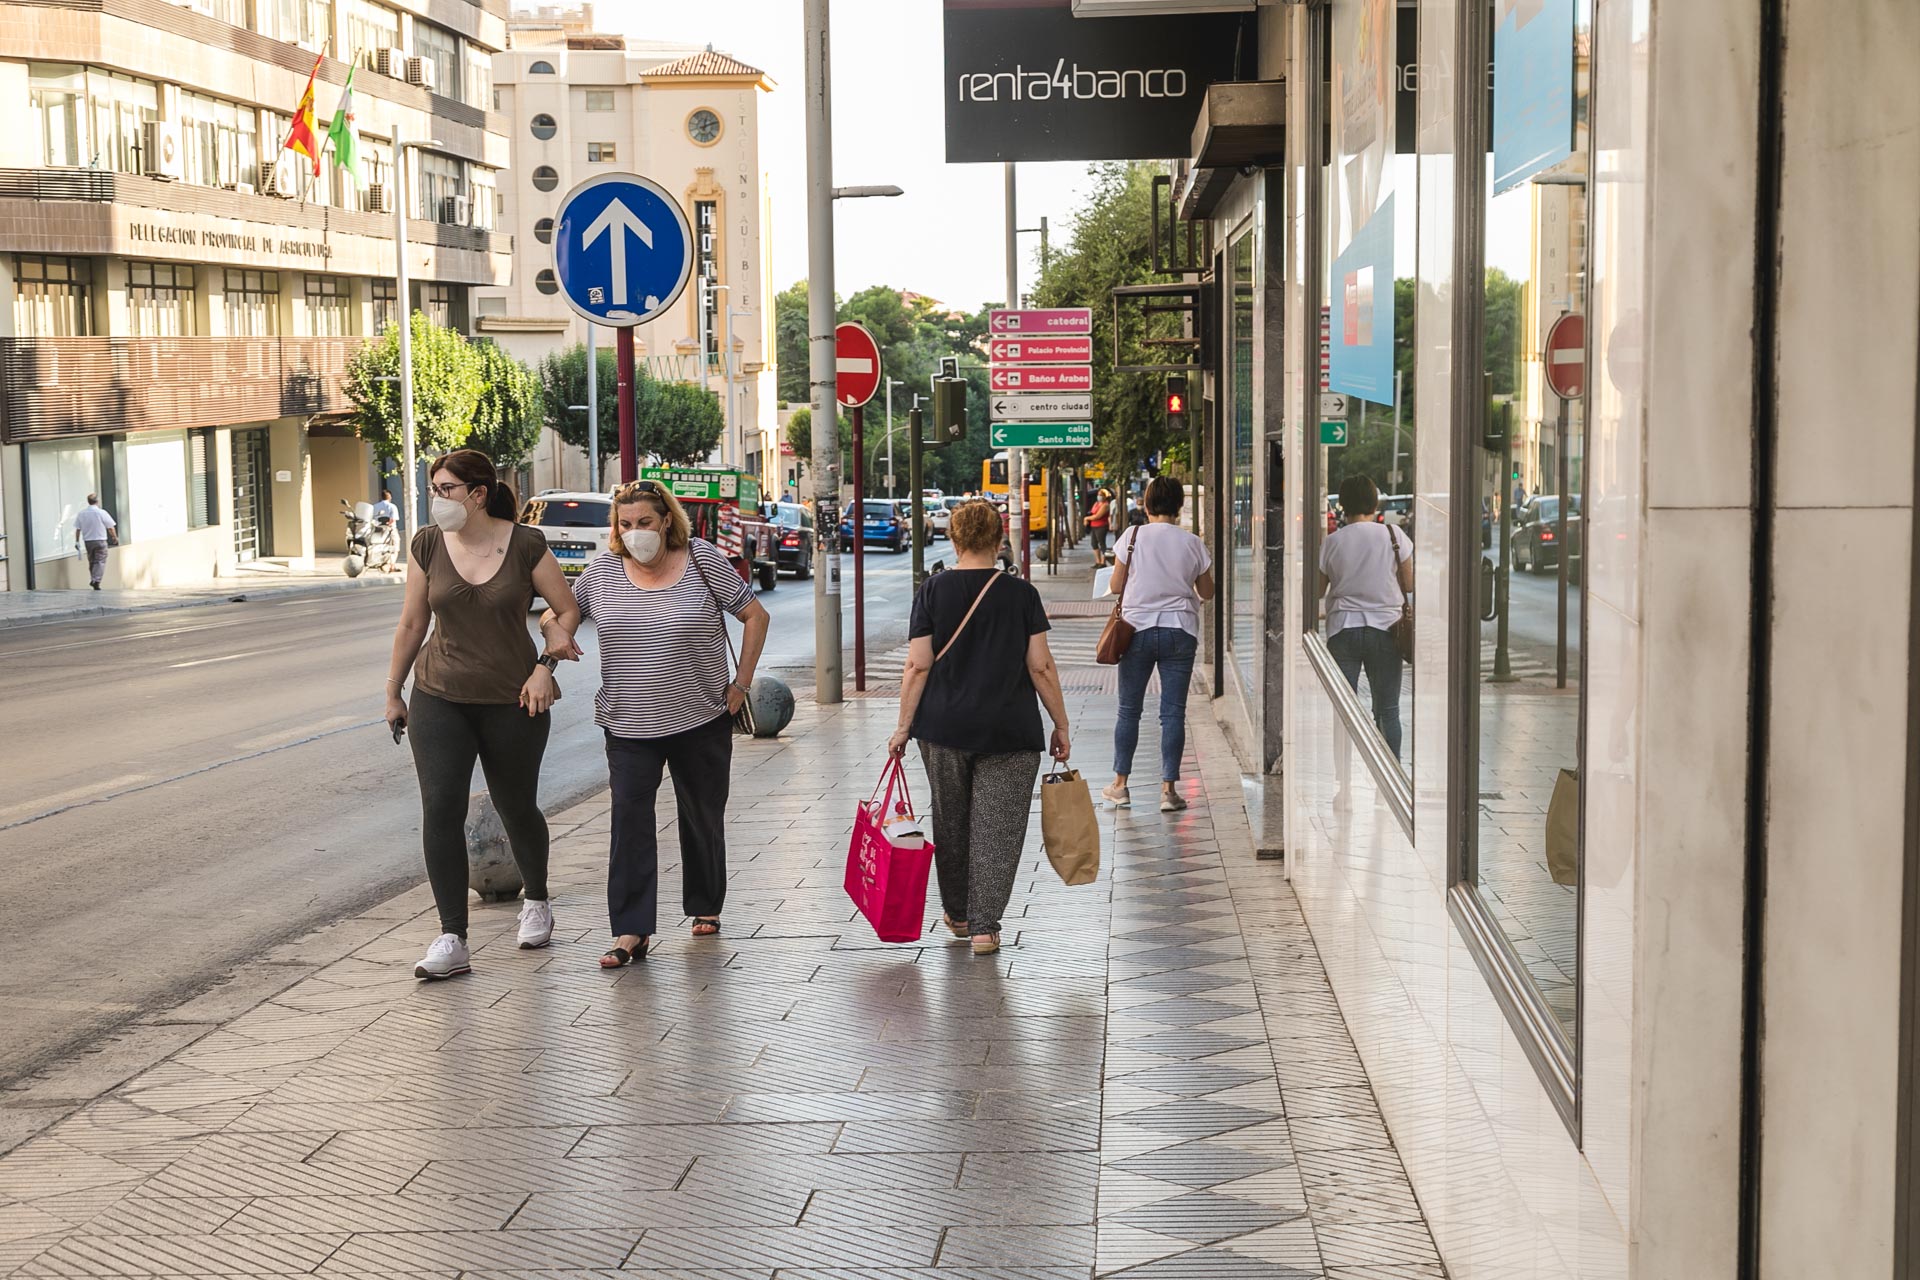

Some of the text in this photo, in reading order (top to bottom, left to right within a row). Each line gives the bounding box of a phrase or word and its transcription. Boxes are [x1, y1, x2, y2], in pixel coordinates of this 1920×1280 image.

[959, 58, 1187, 101] renta4banco
[202, 231, 256, 252] PROVINCIAL
[263, 237, 273, 253] DE
[1047, 317, 1088, 326] catedral
[1055, 346, 1088, 354] Provincial
[1029, 374, 1055, 383] Baños
[1030, 403, 1089, 411] centro ciudad
[1068, 425, 1089, 433] calle
[1038, 436, 1063, 444] Santo
